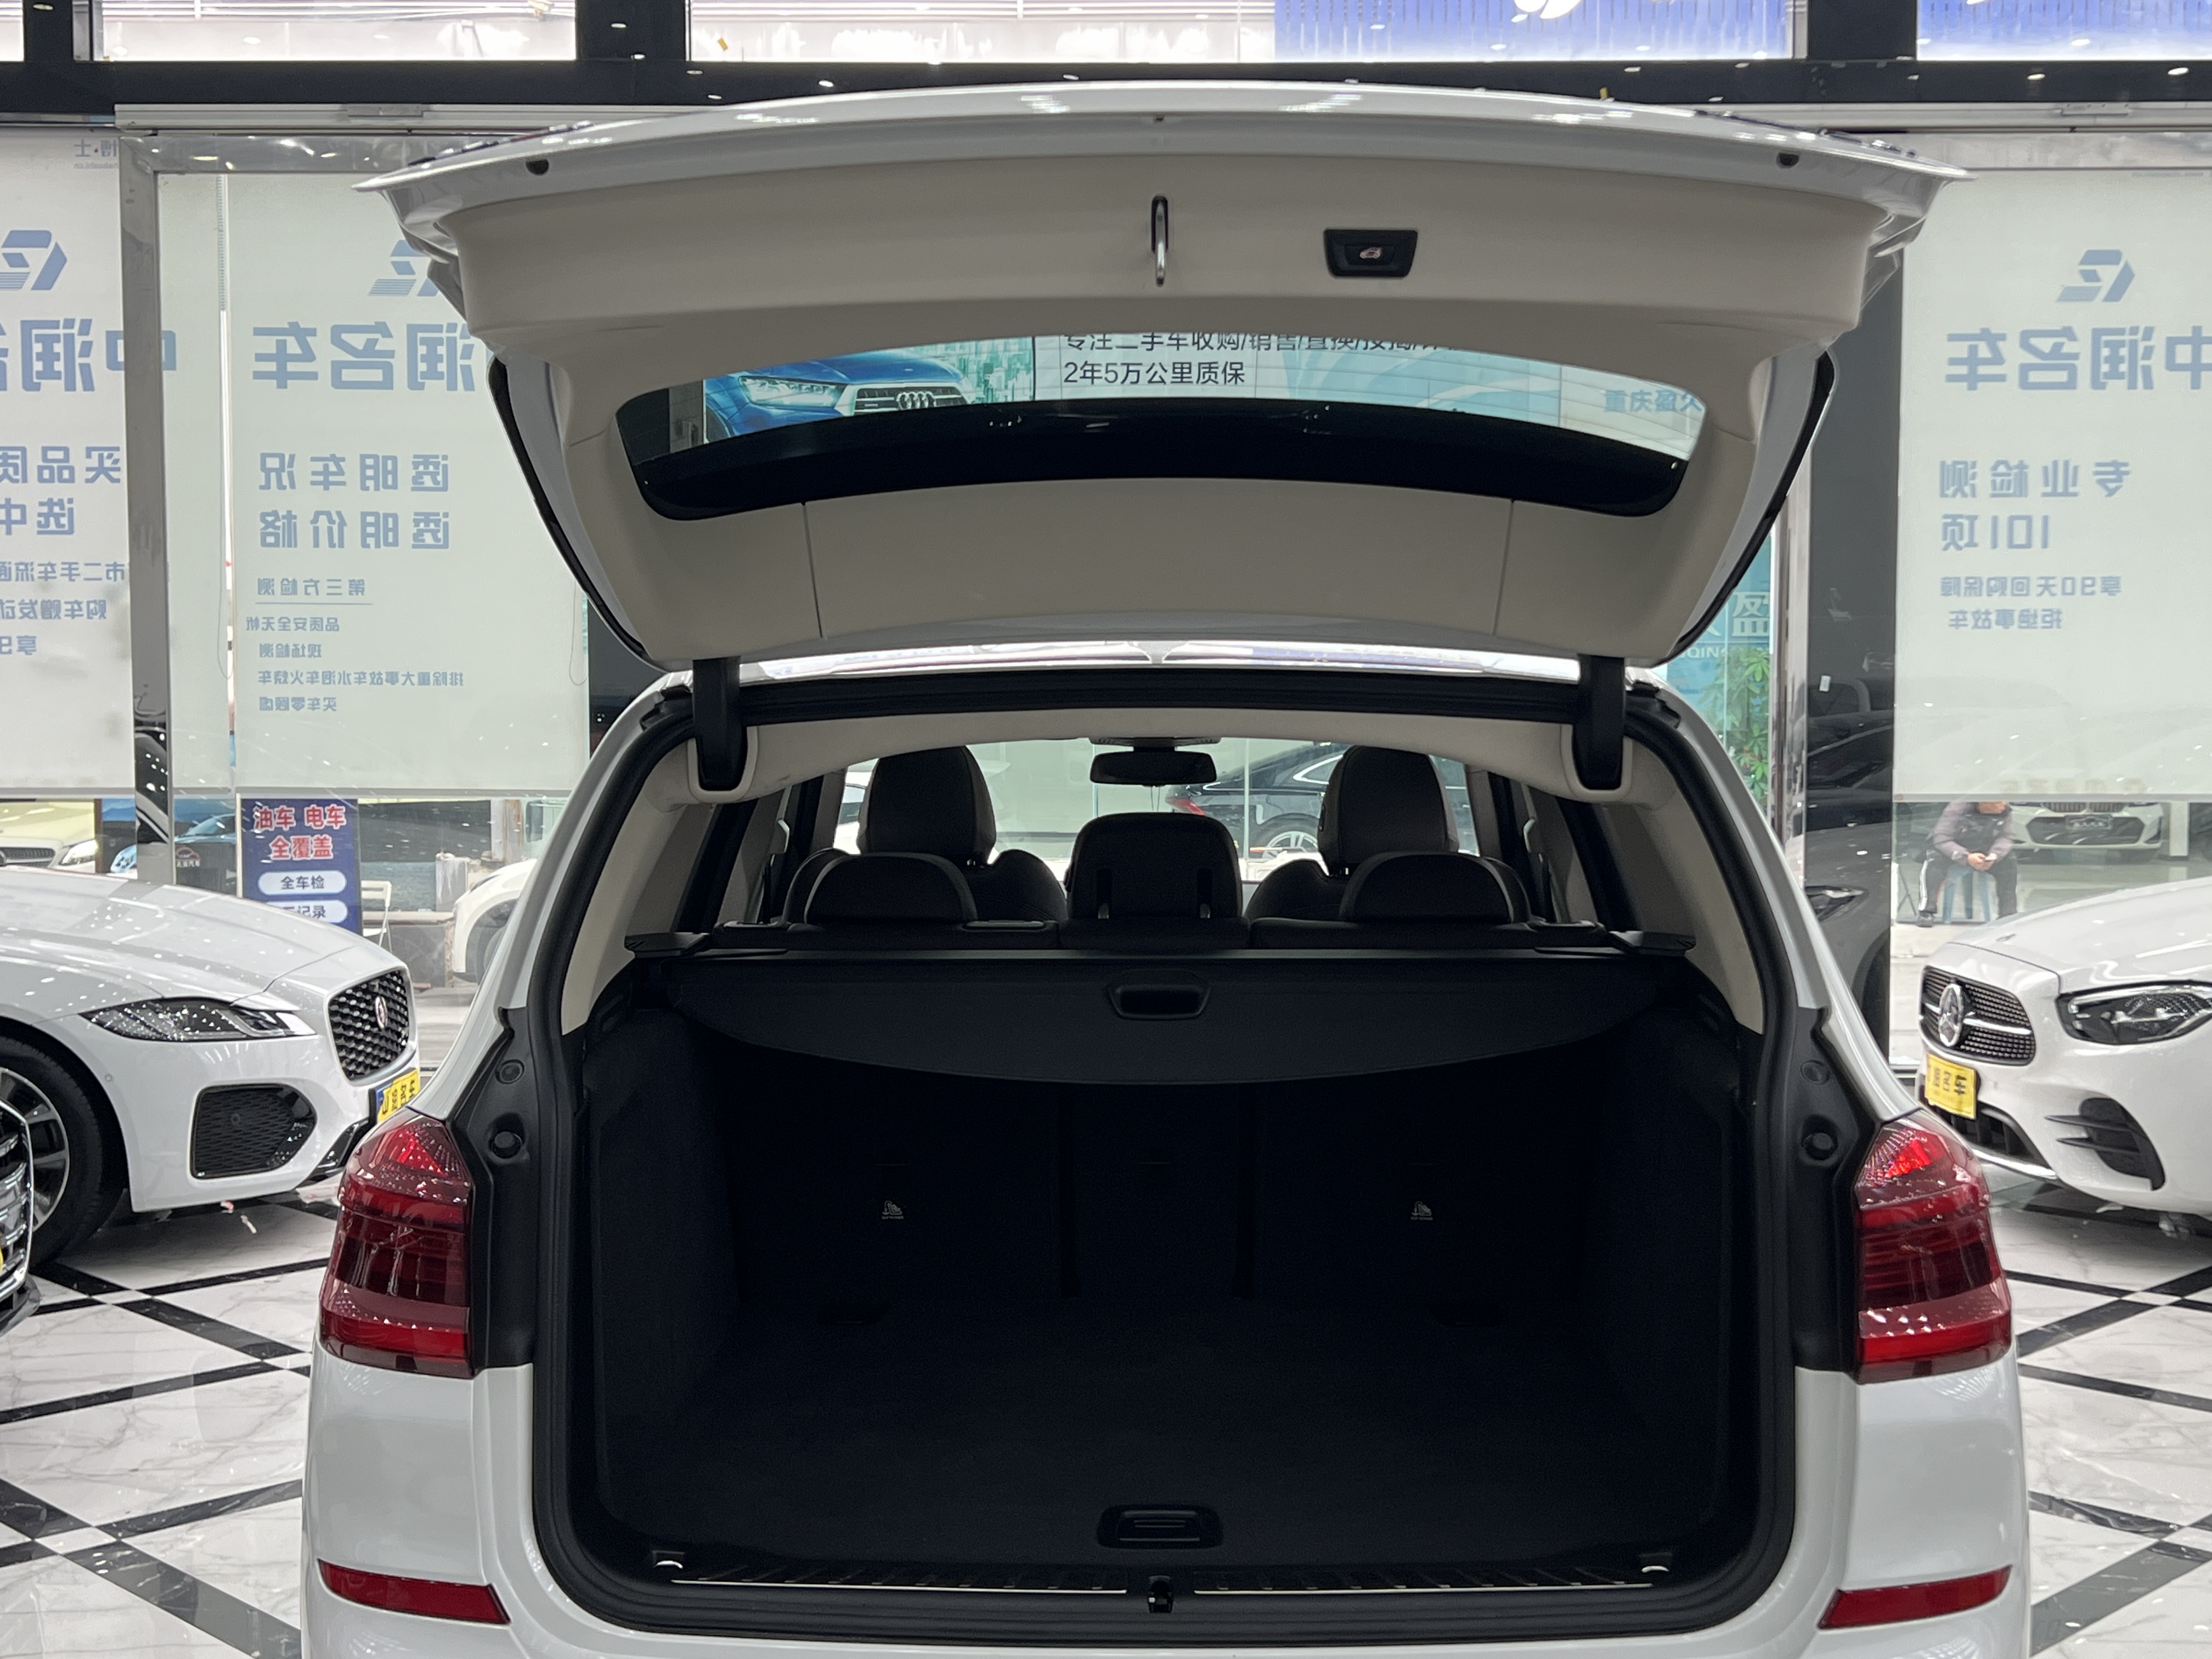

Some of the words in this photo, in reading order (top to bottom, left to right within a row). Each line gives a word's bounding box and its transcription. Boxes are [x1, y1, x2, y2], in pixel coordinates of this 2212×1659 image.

[1064, 361, 1245, 385] 2年5万公里质保
[253, 805, 296, 831] 油车
[303, 804, 347, 829] 电车
[269, 834, 334, 860] 全覆盖
[280, 875, 325, 890] 全车检
[282, 905, 326, 918] 记录
